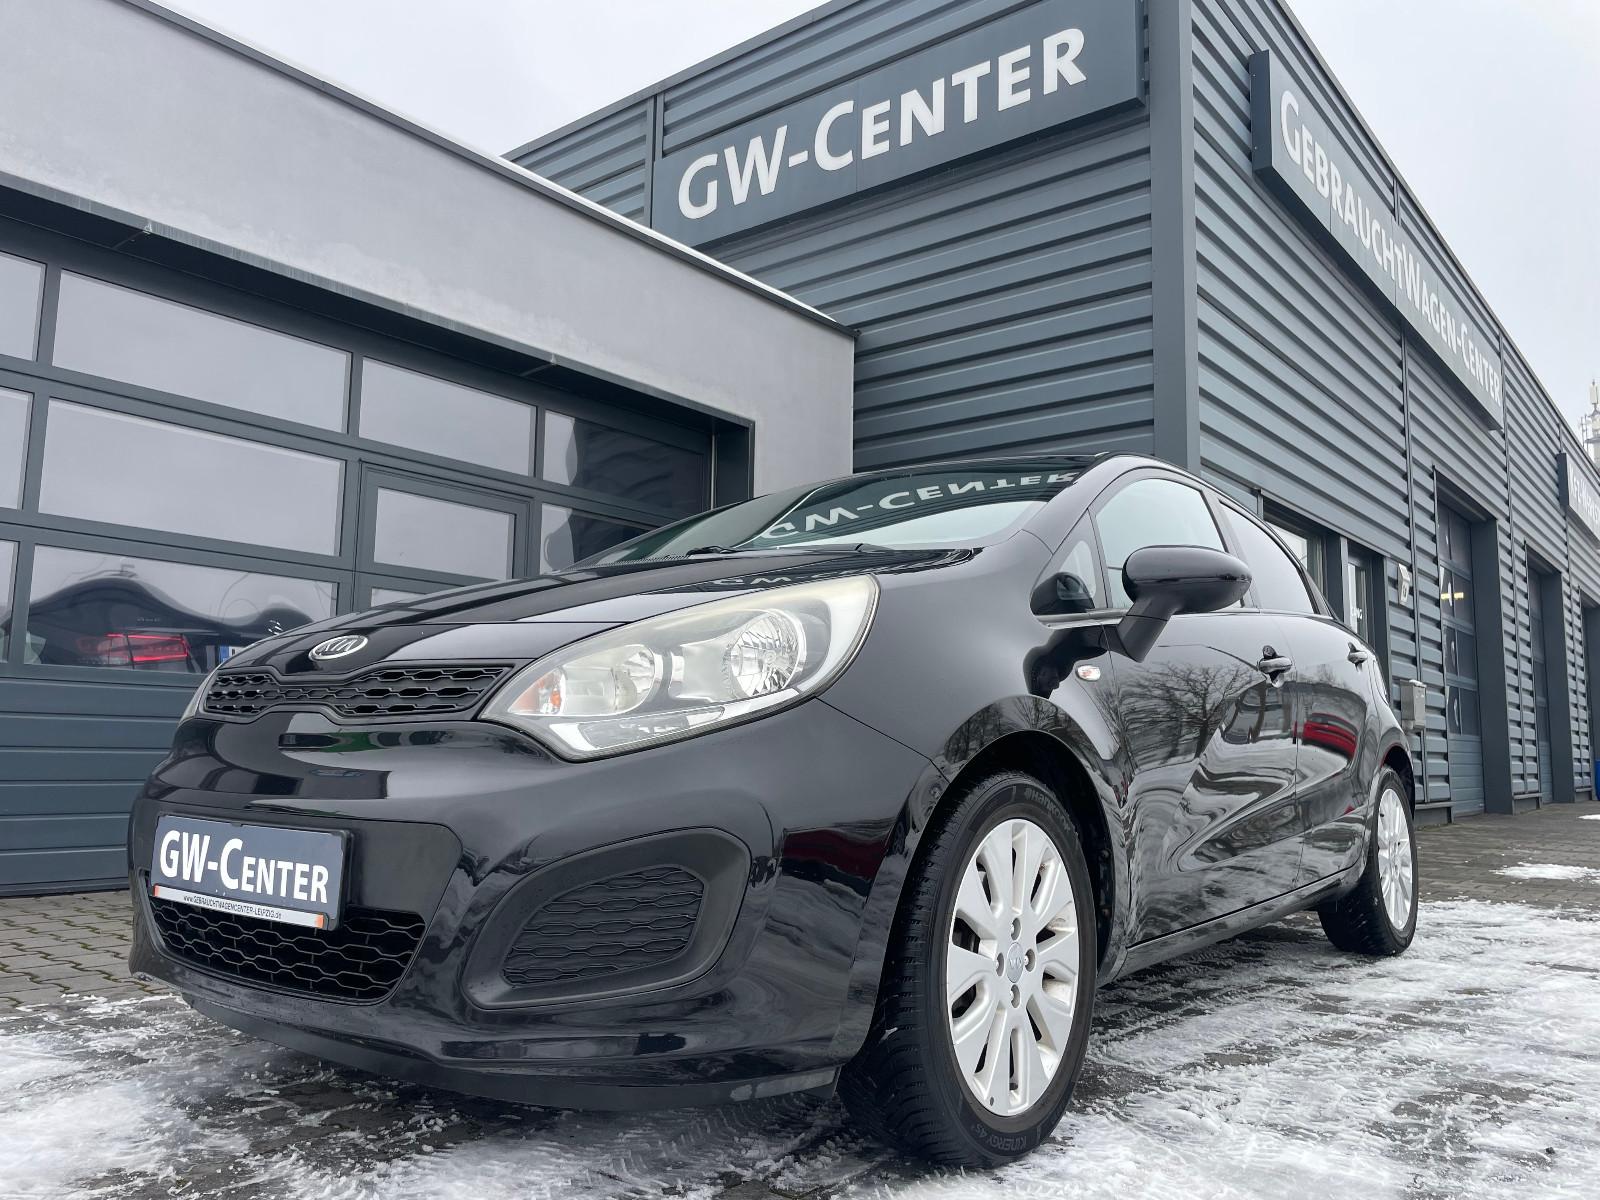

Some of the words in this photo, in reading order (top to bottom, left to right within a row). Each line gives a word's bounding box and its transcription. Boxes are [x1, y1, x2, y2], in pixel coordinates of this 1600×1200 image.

[677, 28, 1087, 220] GW-CENTER
[1280, 90, 1501, 408] GEBRAUCHTWAGEN-CENTER
[160, 830, 329, 904] GW-CENTER
